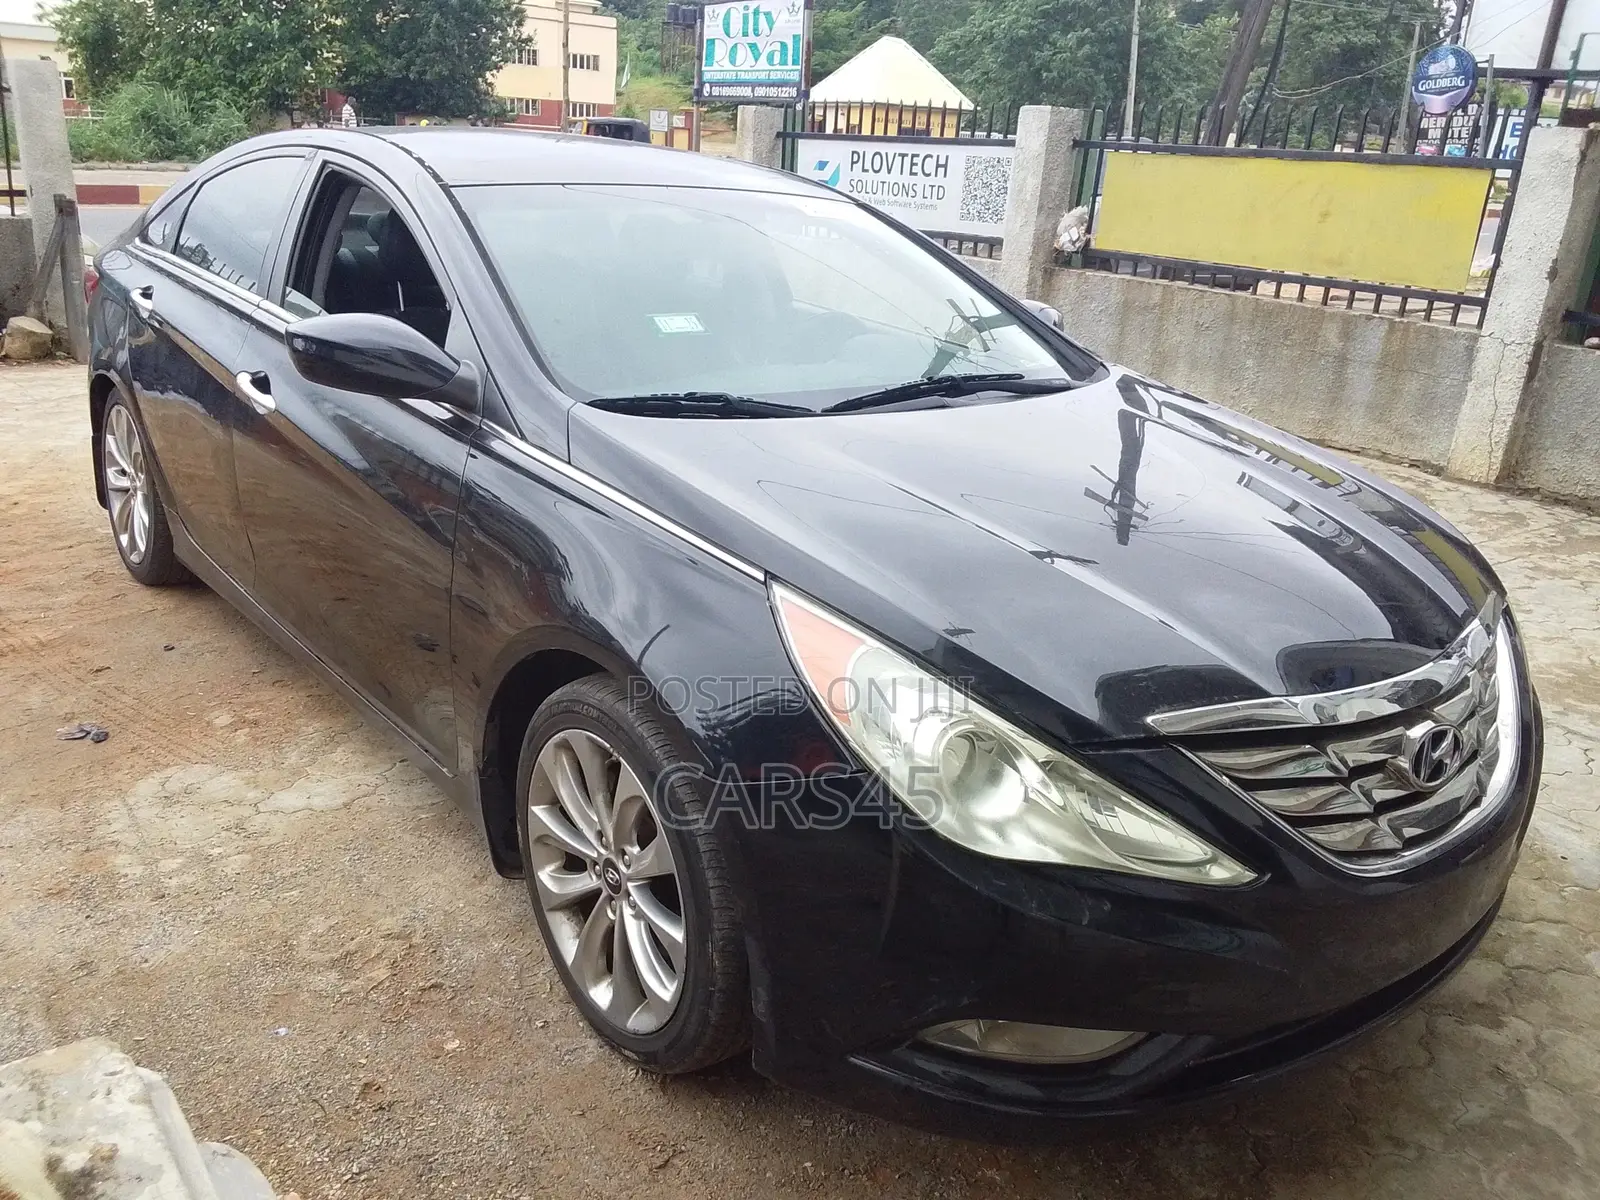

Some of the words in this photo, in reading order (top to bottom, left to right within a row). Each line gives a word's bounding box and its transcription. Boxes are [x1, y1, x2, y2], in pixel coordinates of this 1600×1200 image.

[722, 4, 781, 39] City
[704, 34, 801, 68] Royal
[1418, 76, 1465, 91] GOLDBERG
[850, 150, 950, 178] PLOVTECH
[849, 178, 917, 199] SOLUTIONS
[922, 183, 946, 200] LTD
[887, 198, 912, 209] Software
[913, 201, 938, 211] Systems
